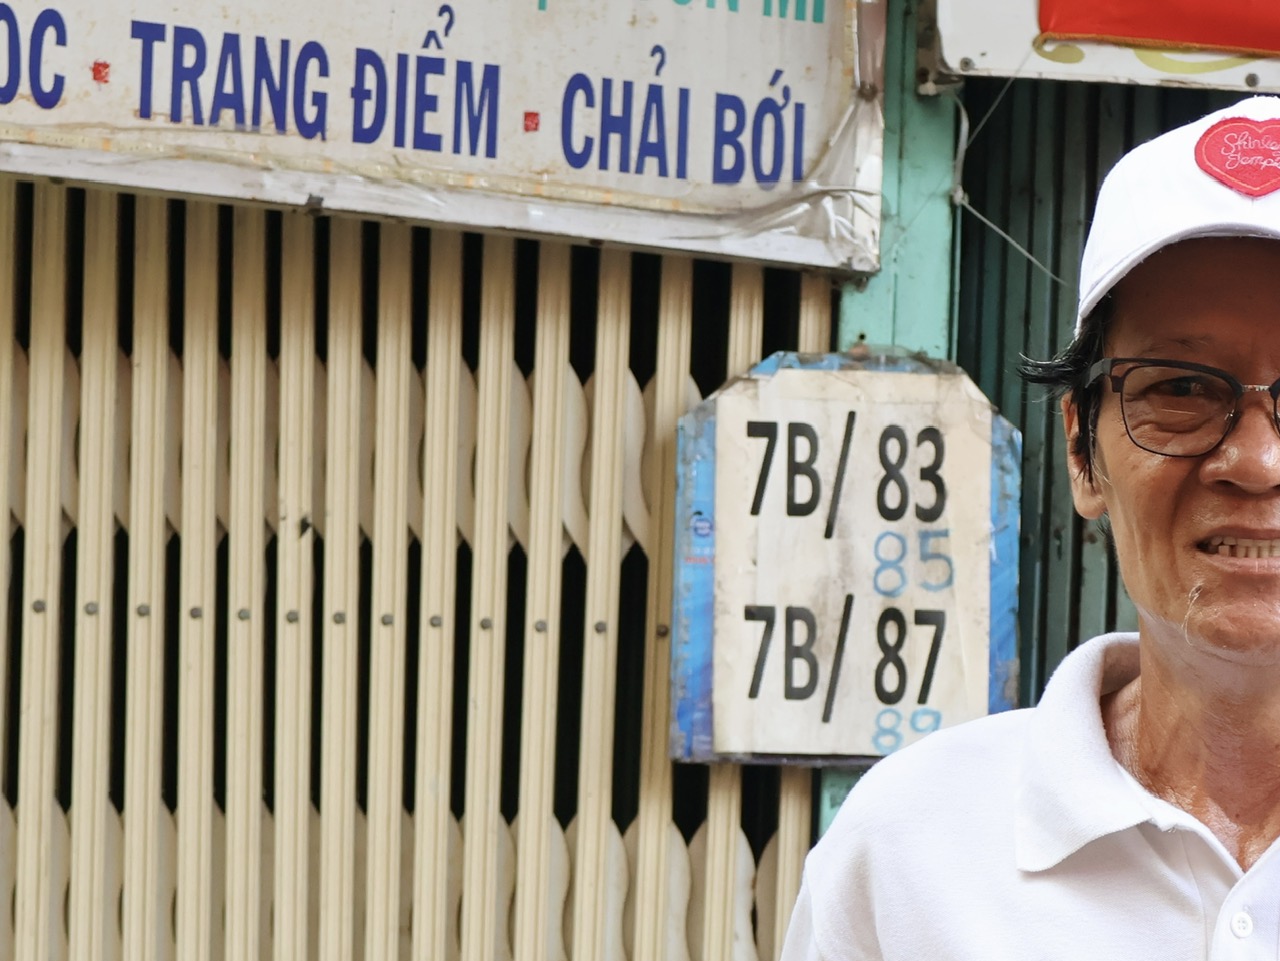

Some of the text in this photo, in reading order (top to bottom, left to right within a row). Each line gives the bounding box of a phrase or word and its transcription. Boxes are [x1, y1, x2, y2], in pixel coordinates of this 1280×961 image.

[130, 20, 329, 141] TRANG
[351, 5, 500, 159] ĐIỂM
[561, 45, 690, 180] CHẢI
[712, 70, 806, 191] BỚI
[872, 528, 955, 598] 85
